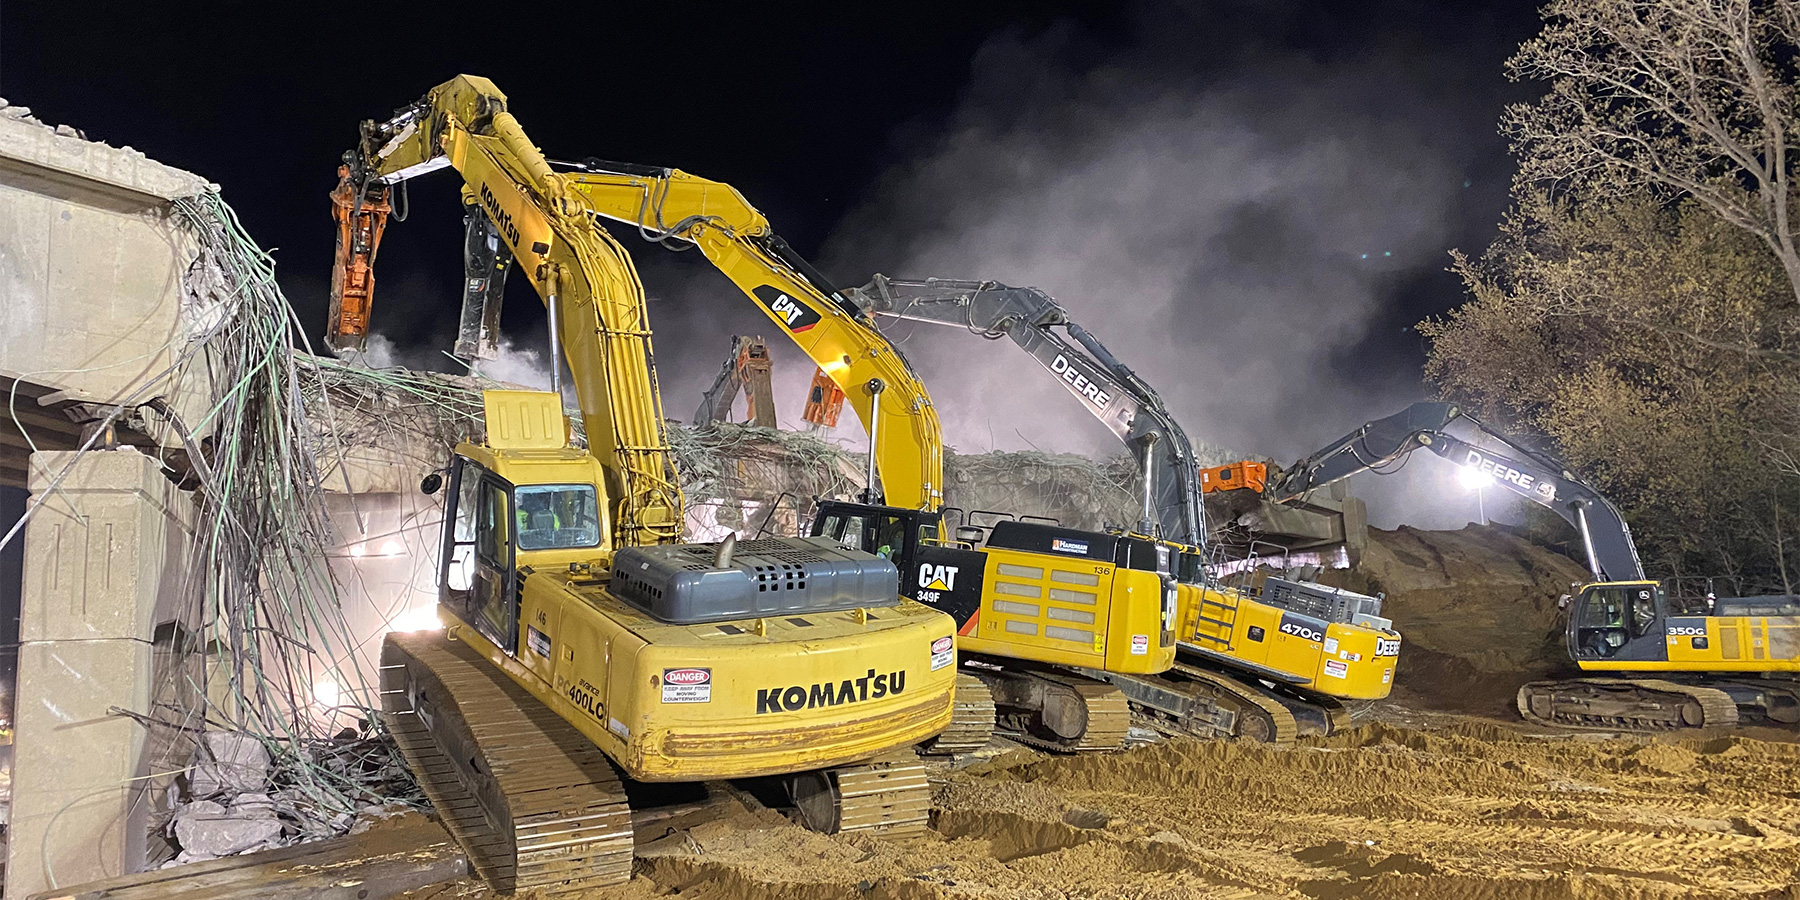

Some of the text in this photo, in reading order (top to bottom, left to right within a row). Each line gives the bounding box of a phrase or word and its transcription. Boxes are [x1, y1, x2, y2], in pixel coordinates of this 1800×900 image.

[480, 182, 520, 248] KOMATSU
[771, 294, 804, 326] CAT
[1050, 354, 1111, 410] DEERE
[1465, 450, 1535, 490] DEERE
[918, 563, 959, 591] CAT
[1093, 566, 1111, 575] 136
[916, 590, 941, 603] 349F
[535, 608, 547, 626] 146
[1281, 623, 1322, 642] 470G
[1668, 627, 1705, 635] 350G
[670, 673, 704, 682] DANGER
[578, 678, 601, 697] avance
[756, 668, 906, 715] KOMATSU
